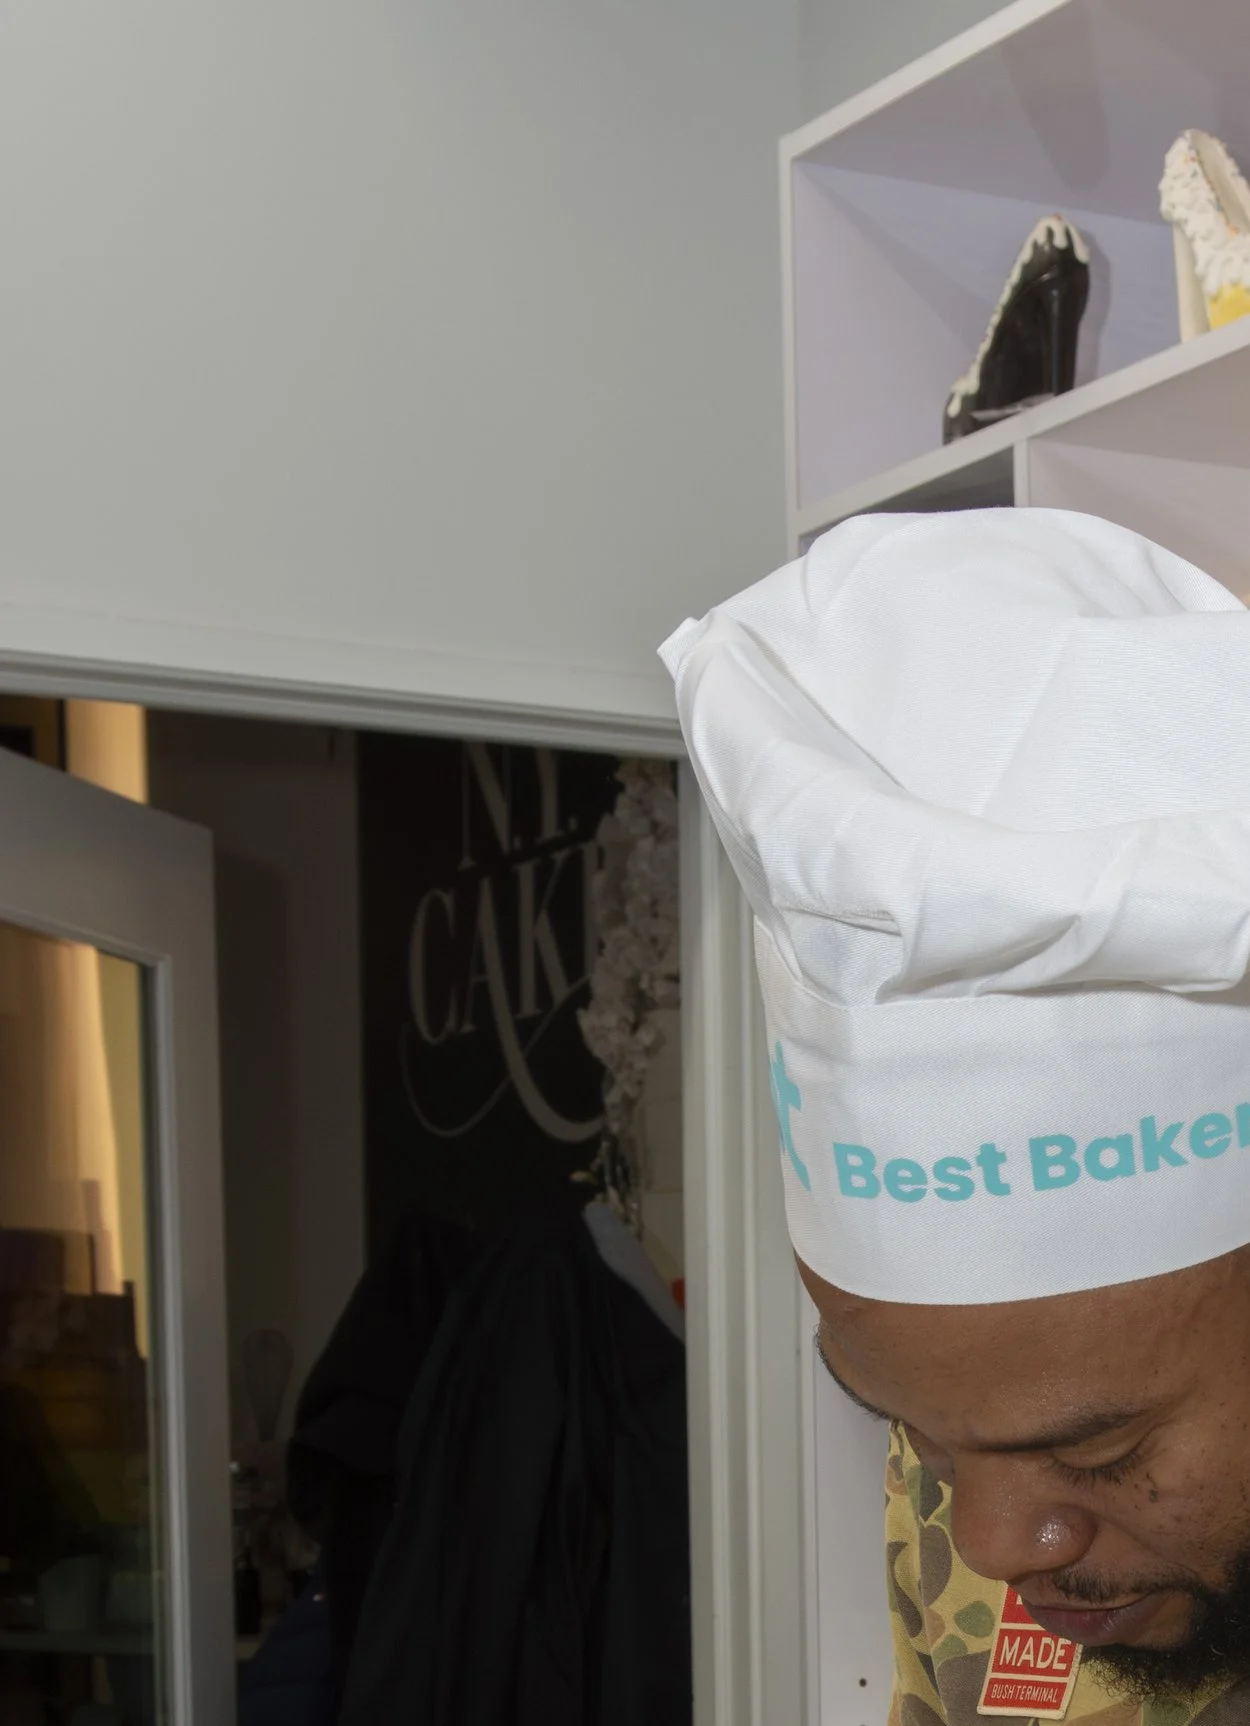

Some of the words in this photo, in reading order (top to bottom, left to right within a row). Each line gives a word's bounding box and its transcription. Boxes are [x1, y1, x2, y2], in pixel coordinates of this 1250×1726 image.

[832, 1141, 1011, 1203] Best
[999, 1635, 1072, 1671] MADE
[991, 1684, 1015, 1700] BUSH
[1014, 1685, 1057, 1703] TERMINAL
